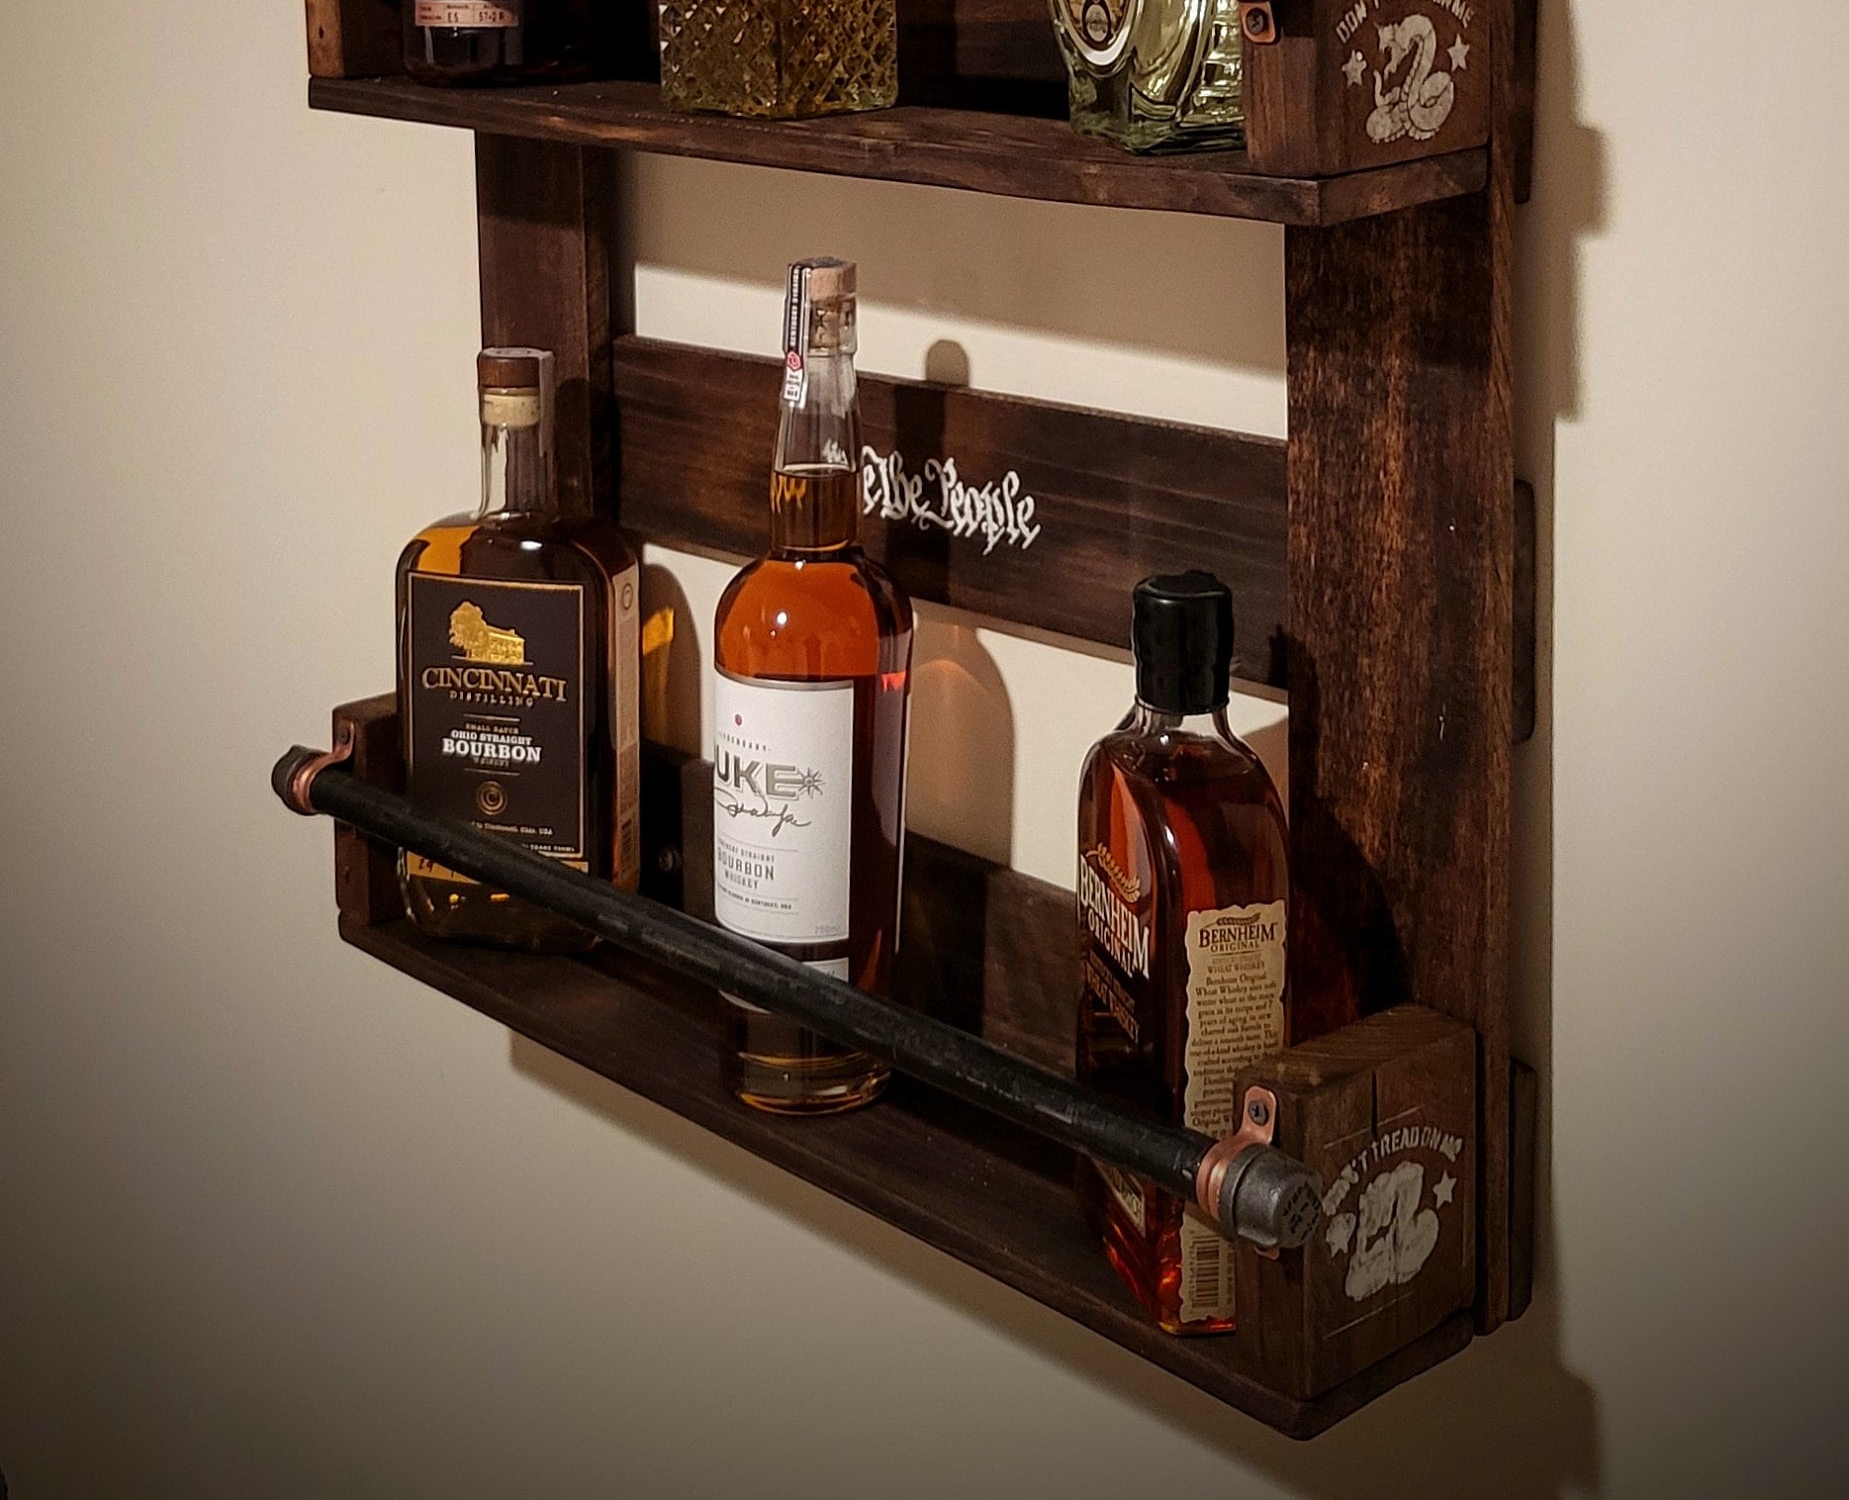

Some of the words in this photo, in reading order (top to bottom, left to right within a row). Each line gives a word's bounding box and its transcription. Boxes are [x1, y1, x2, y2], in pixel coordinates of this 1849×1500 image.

[917, 457, 1042, 557] People
[421, 666, 568, 703] CINCINNATI
[449, 689, 535, 708] DISTILLING
[441, 737, 543, 764] BOURBON
[450, 729, 478, 741] OHIO
[478, 731, 533, 746] STRAIGHT
[715, 744, 798, 799] UKE
[718, 846, 775, 882] BOURBON
[724, 869, 759, 890] WHISKEY
[1079, 852, 1150, 981] BERNHEIM
[1087, 907, 1134, 980] ORIGINAL
[1198, 922, 1275, 948] BERNHEIM
[1210, 940, 1260, 953] ORIGINAL
[1371, 1125, 1421, 1163] TREAD
[1420, 1126, 1443, 1152] ON
